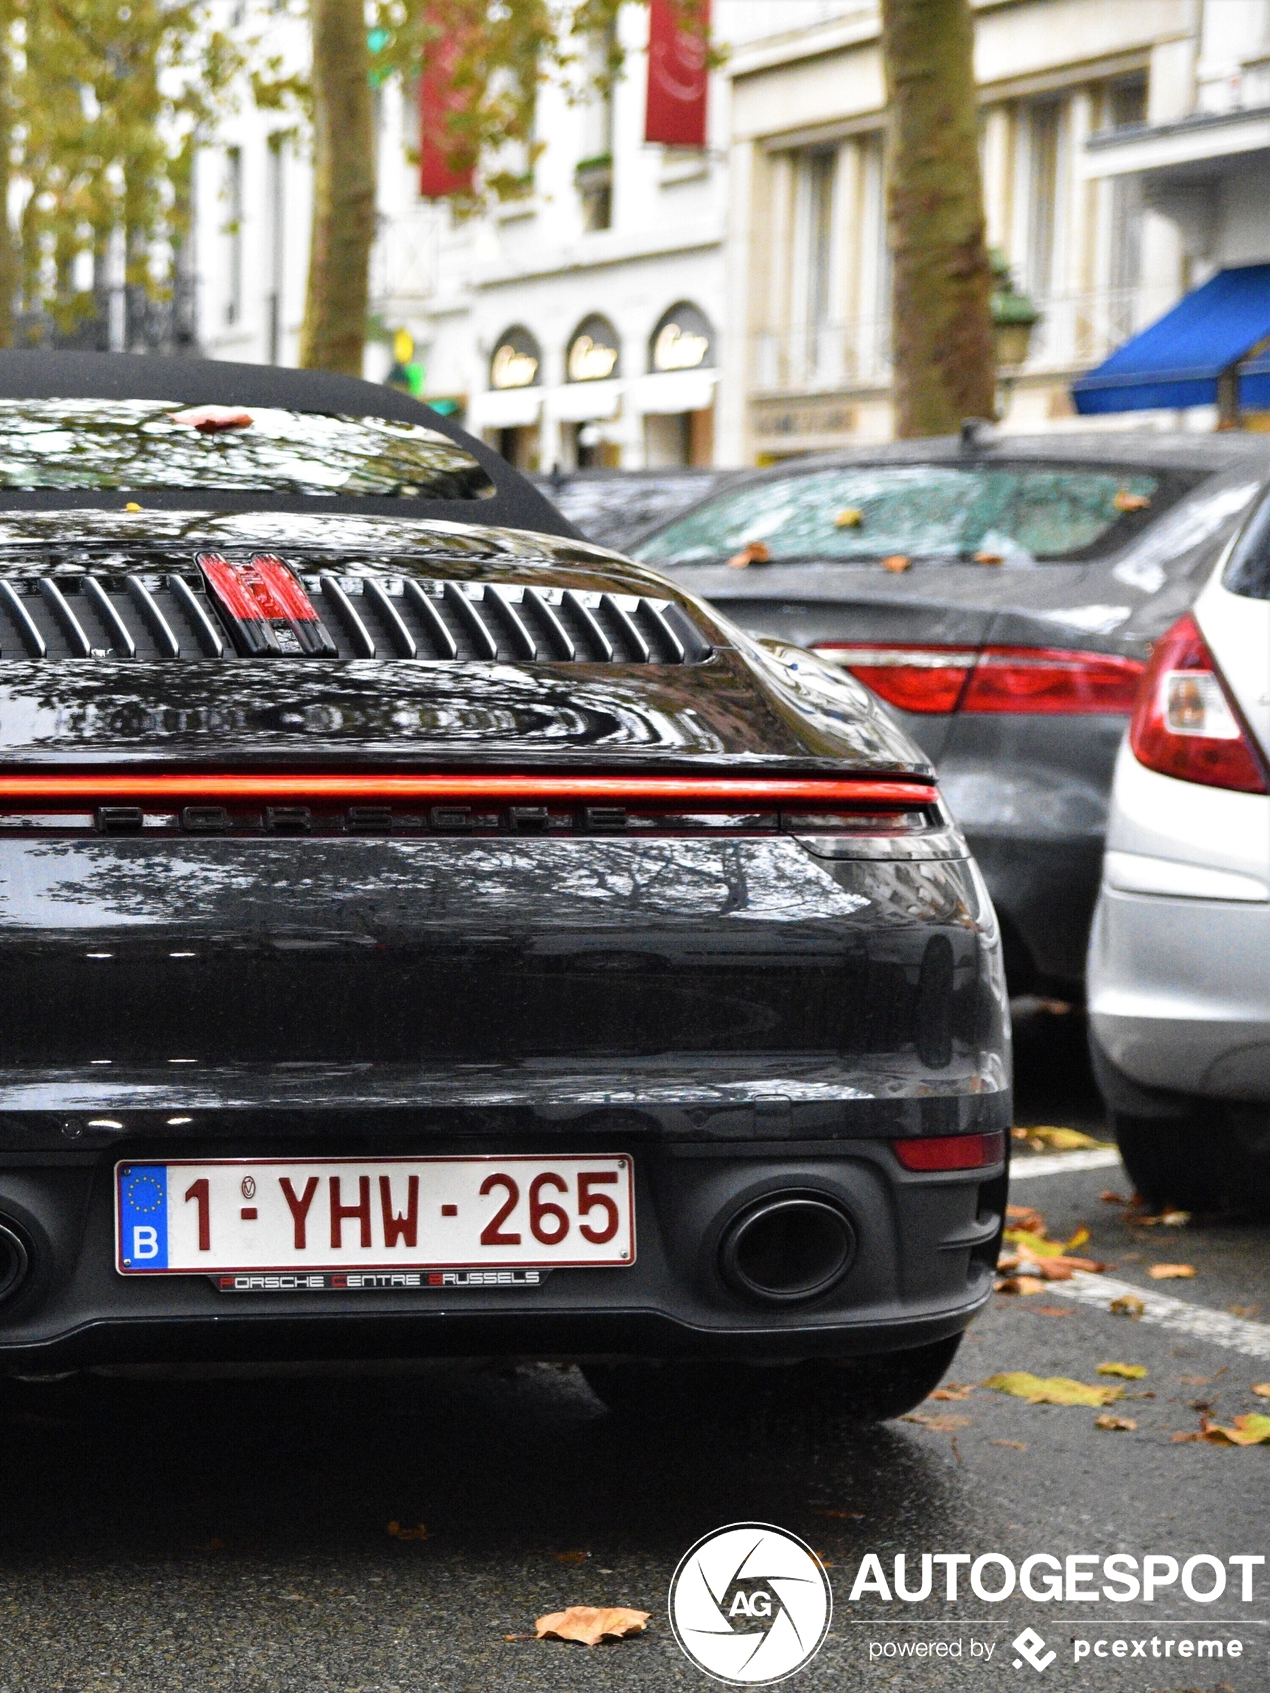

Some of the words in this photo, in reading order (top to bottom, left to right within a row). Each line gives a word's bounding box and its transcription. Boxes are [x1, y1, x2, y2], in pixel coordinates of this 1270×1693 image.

[133, 1226, 158, 1260] B
[220, 1275, 324, 1289] PORSCHE
[332, 1273, 421, 1288] CENTRE
[428, 1271, 540, 1287] BRUSSELS
